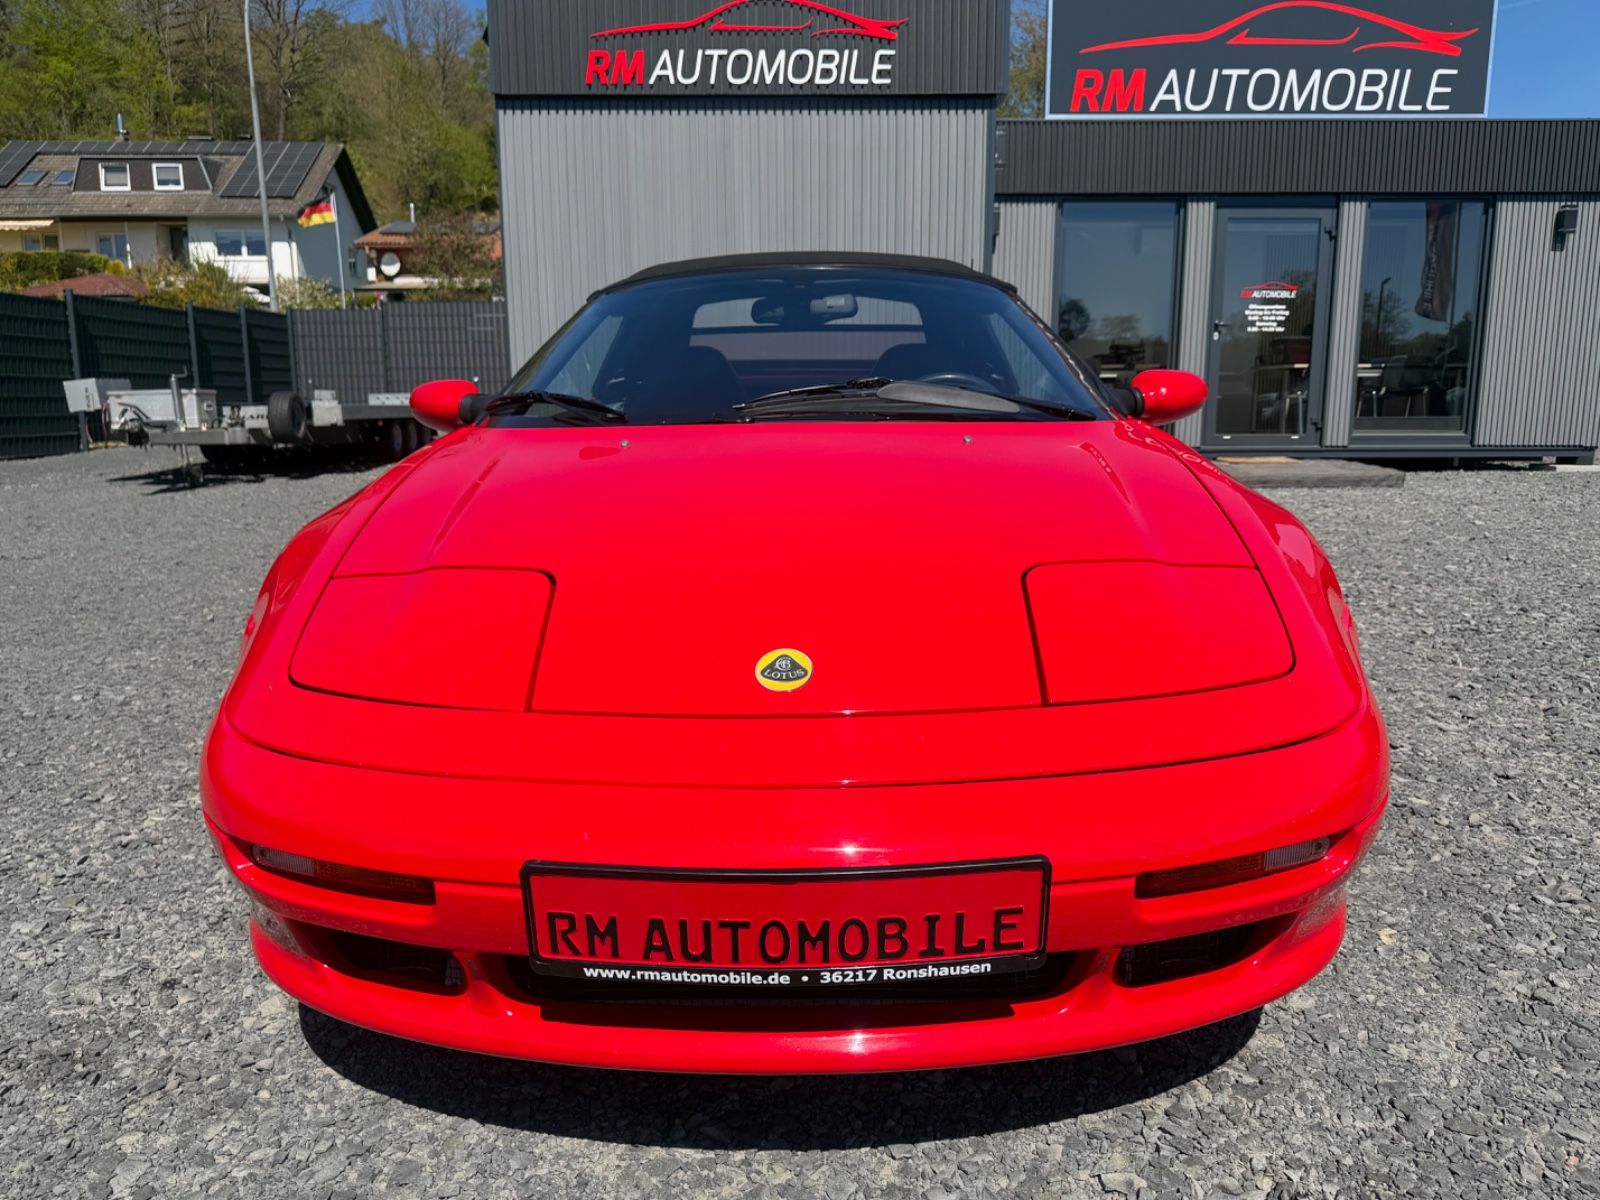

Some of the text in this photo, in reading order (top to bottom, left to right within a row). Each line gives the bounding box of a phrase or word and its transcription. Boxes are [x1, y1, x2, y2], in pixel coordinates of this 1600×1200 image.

[584, 48, 896, 85] RM AUTOMOBILE
[1070, 69, 1458, 112] RM AUTOMOBILE
[1251, 290, 1297, 298] AUTOMOBILE
[764, 669, 805, 680] LOTUS
[547, 907, 1024, 964] RM AUTOMOBILE
[583, 962, 992, 985] www.rmautomobile.de 36217 Ronshausen
